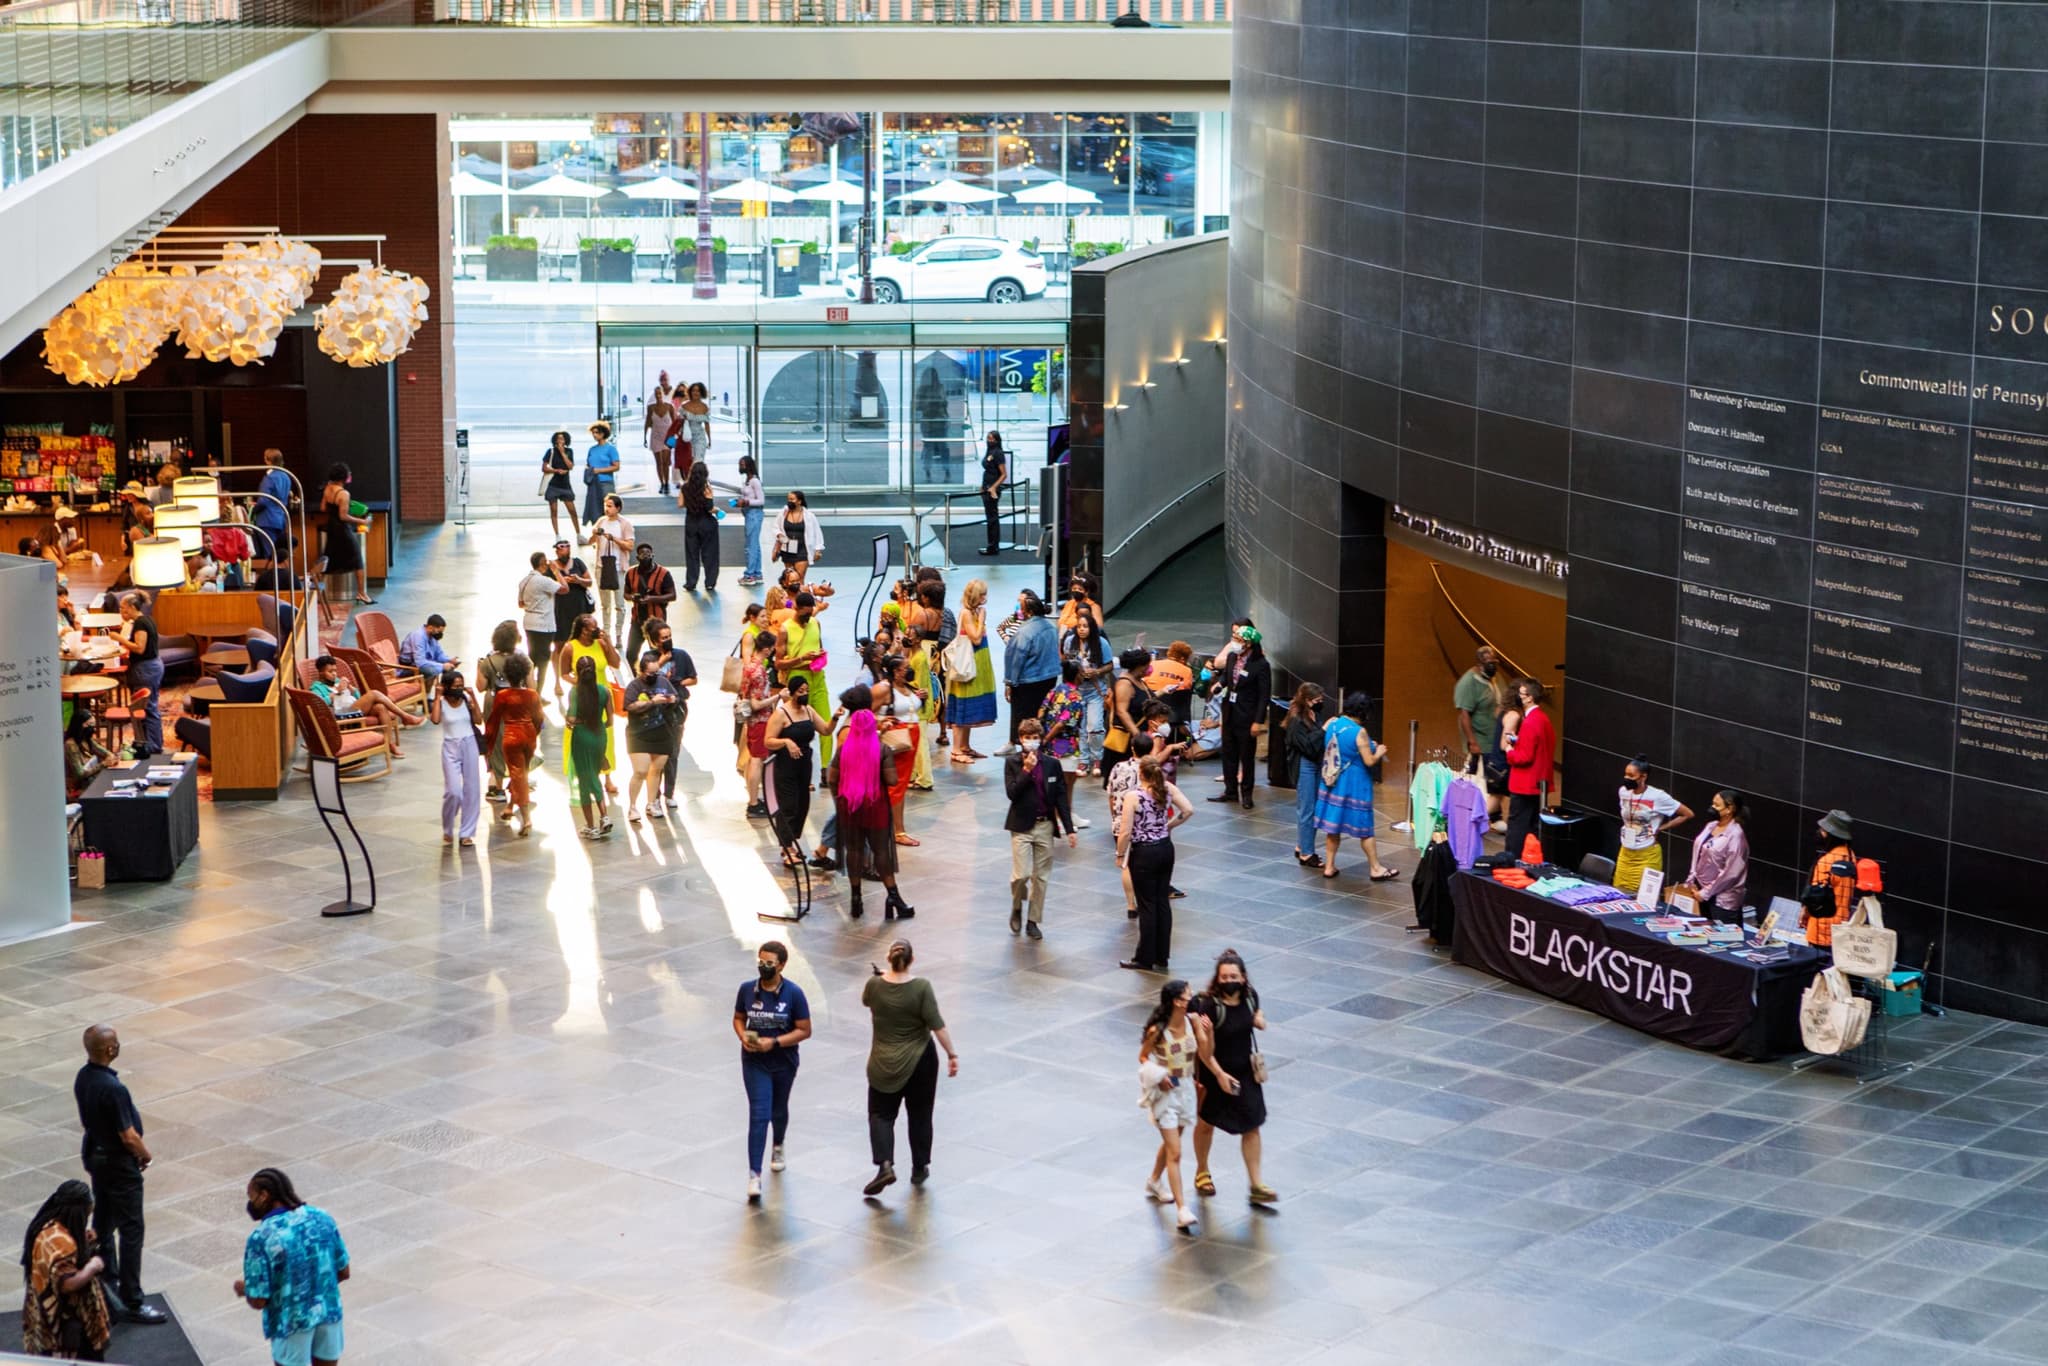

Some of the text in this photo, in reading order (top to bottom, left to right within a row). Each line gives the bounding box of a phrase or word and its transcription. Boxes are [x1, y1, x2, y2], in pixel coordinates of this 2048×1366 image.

[1990, 305, 2048, 335] SO
[1860, 370, 1966, 397] Commonwealth
[1972, 384, 1989, 400] of
[1690, 389, 1786, 413] The Annenberg Foundation
[1822, 409, 1840, 419] Barra
[1841, 412, 1880, 425] Foundation
[1887, 419, 1910, 430] Robert
[1688, 422, 1765, 443] Dorrance H. Hamilton
[1687, 454, 1770, 477] The Lenfest Foundation
[1686, 486, 1799, 516] Ruth and Raymond G. Perelman
[1685, 519, 1776, 545] The Pew Charitable Trusts
[1818, 511, 1850, 524] Delaware
[1852, 516, 1868, 527] River
[1886, 522, 1919, 537] Authority
[1683, 550, 1710, 564] Verizon
[1817, 544, 1907, 568] Otto Haas Charitable Trust
[1682, 583, 1771, 610] William Penn Foundation
[1815, 578, 1903, 601] Independence Foundation
[1681, 615, 1693, 626] The
[1721, 625, 1739, 637] Fund
[1815, 611, 1826, 620] The
[1851, 618, 1891, 634] Foundation
[1813, 644, 1922, 674] The Merck Company Foundation
[1810, 678, 1840, 692] SUNOCO
[1809, 711, 1842, 726] Wachovia
[1510, 912, 1692, 1016] BLACKSTAR
